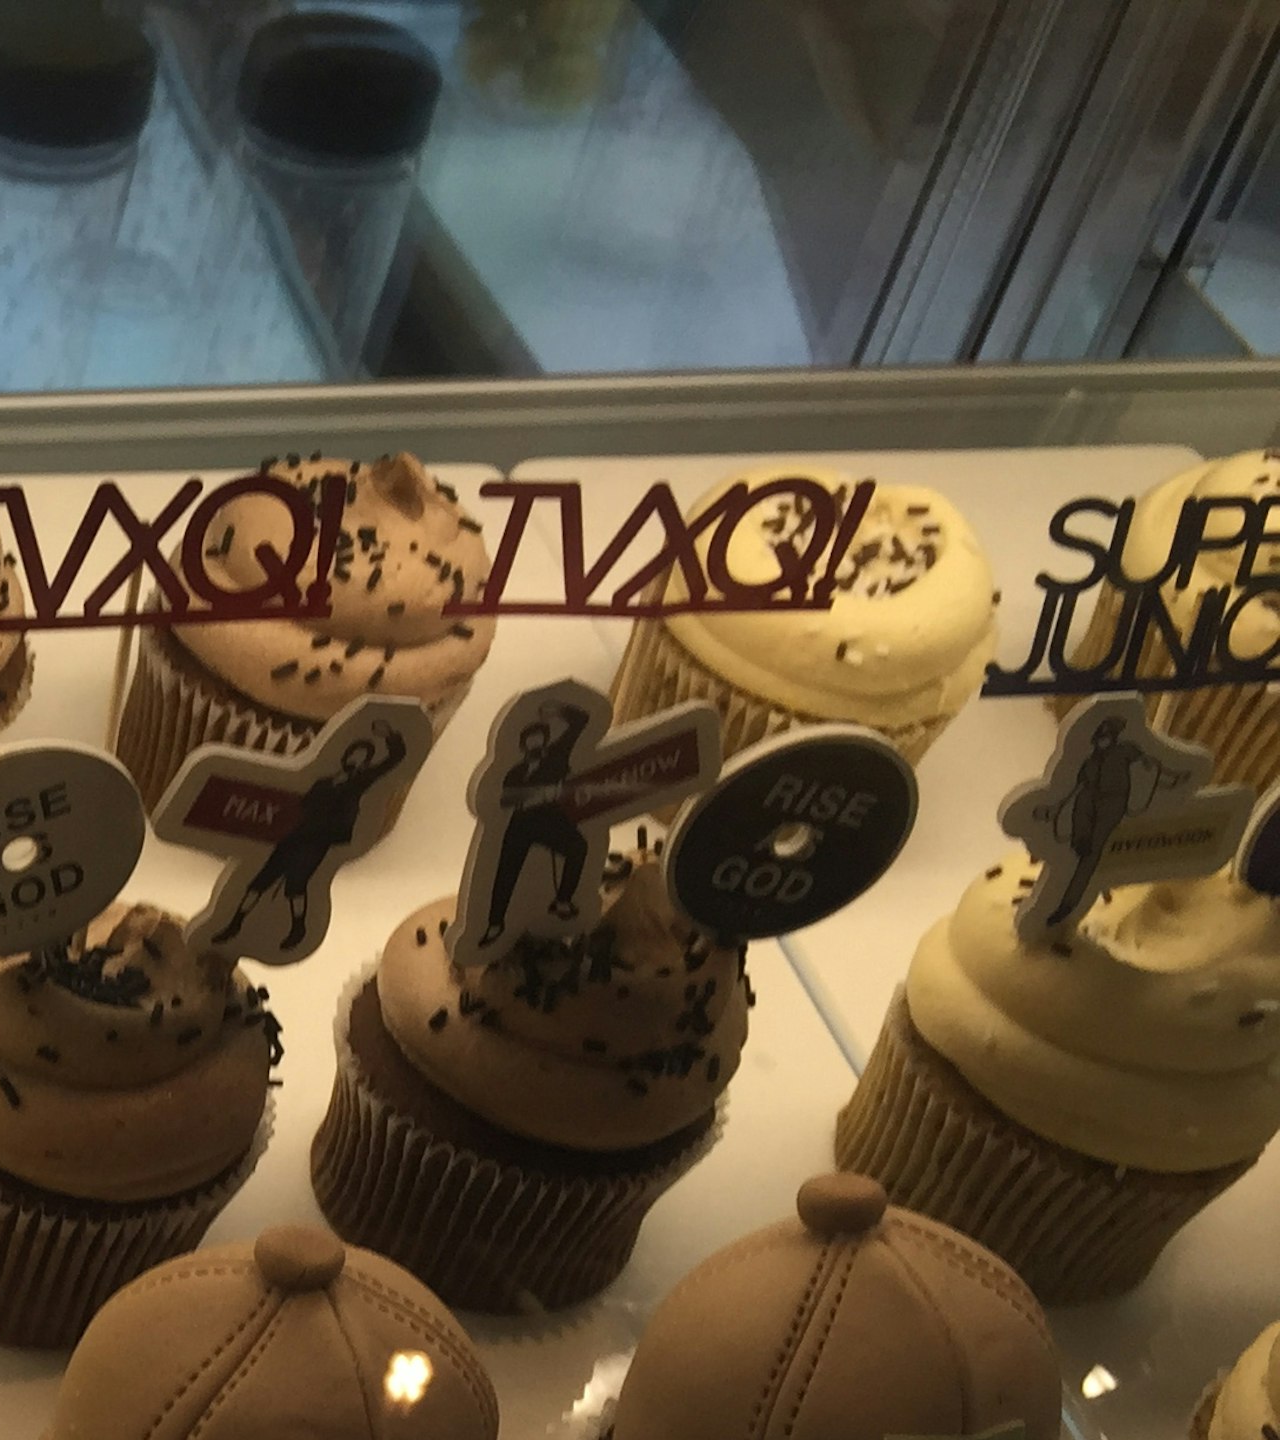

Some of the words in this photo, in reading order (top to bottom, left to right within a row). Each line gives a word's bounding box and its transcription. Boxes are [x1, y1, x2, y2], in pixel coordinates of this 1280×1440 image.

[479, 478, 877, 605] TVXQ!
[1035, 495, 1280, 590] SUPE
[984, 576, 1280, 684] JUNIO
[221, 793, 281, 827] MAX
[761, 773, 879, 829] RISE
[711, 854, 815, 905] GOD
